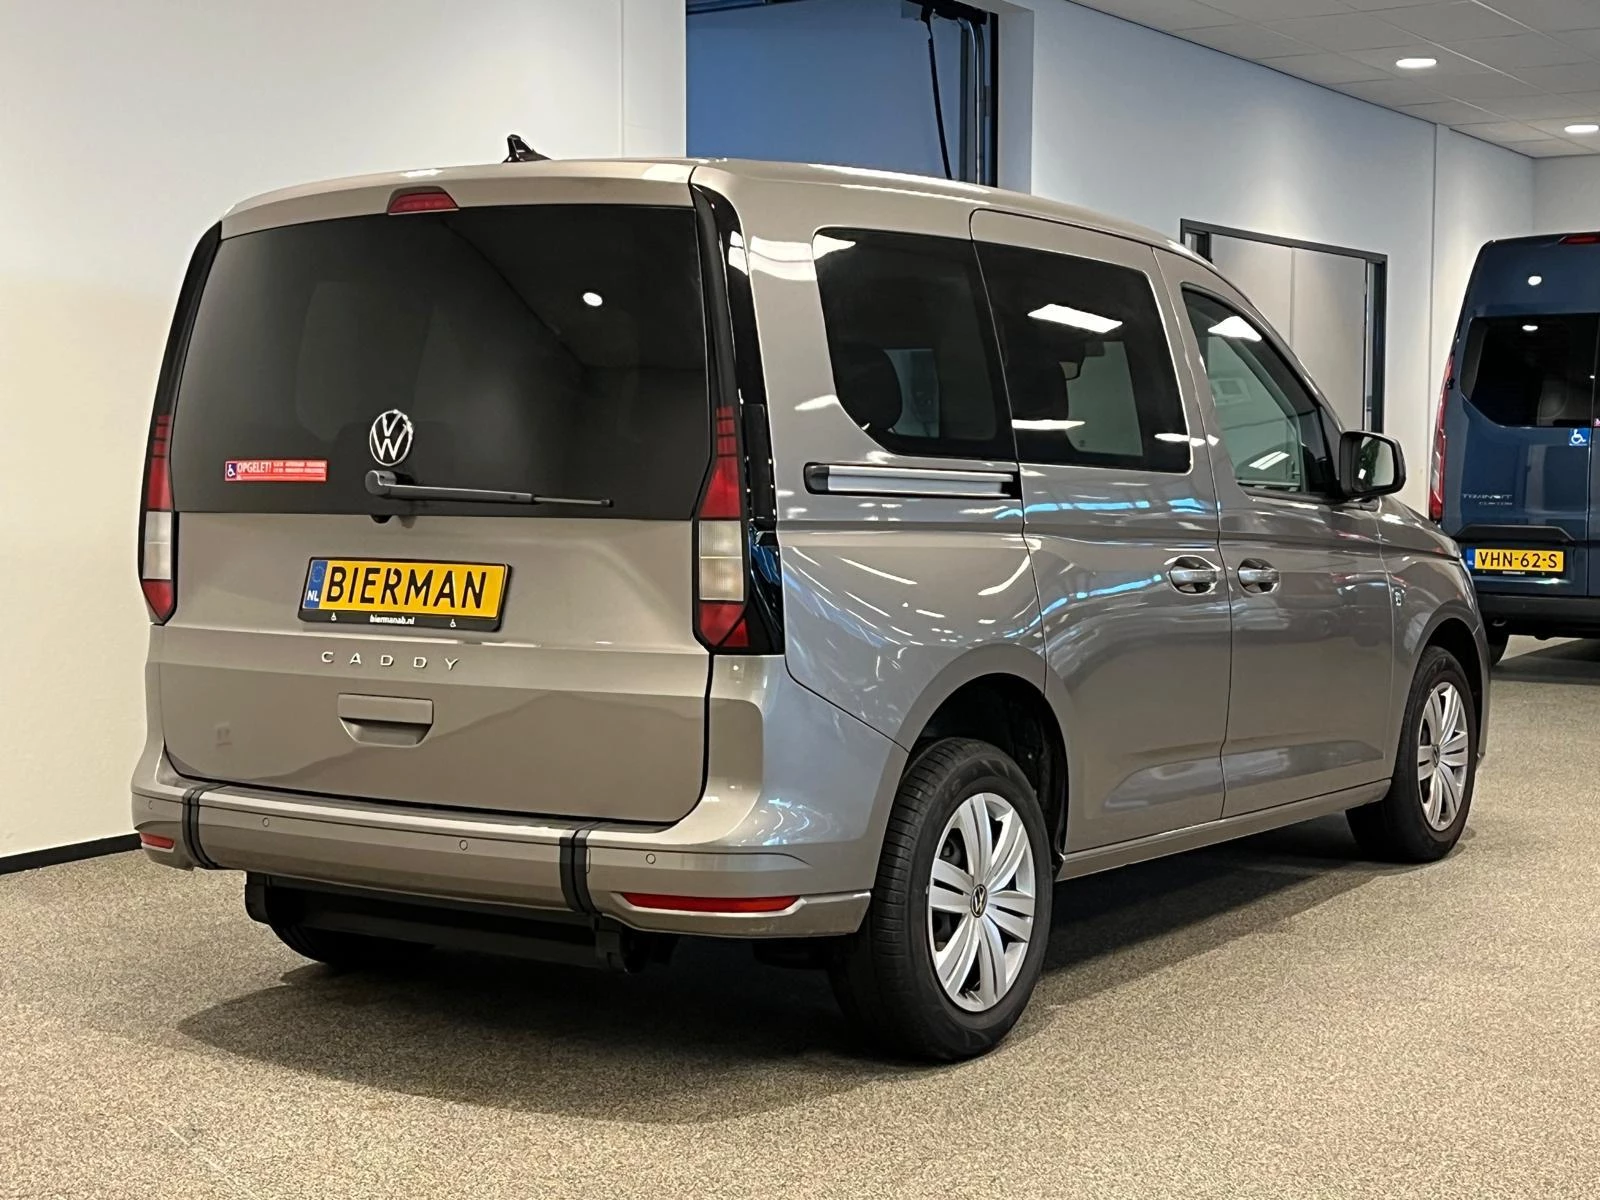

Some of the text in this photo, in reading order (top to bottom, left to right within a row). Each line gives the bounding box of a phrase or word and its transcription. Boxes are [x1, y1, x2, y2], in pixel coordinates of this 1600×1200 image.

[237, 462, 272, 473] OPGELET!
[1479, 551, 1558, 569] VHN-62-S
[326, 566, 487, 609] BIERMAN
[307, 590, 320, 602] NL
[369, 613, 416, 625] biermanab.nl
[321, 651, 459, 670] CADDY
